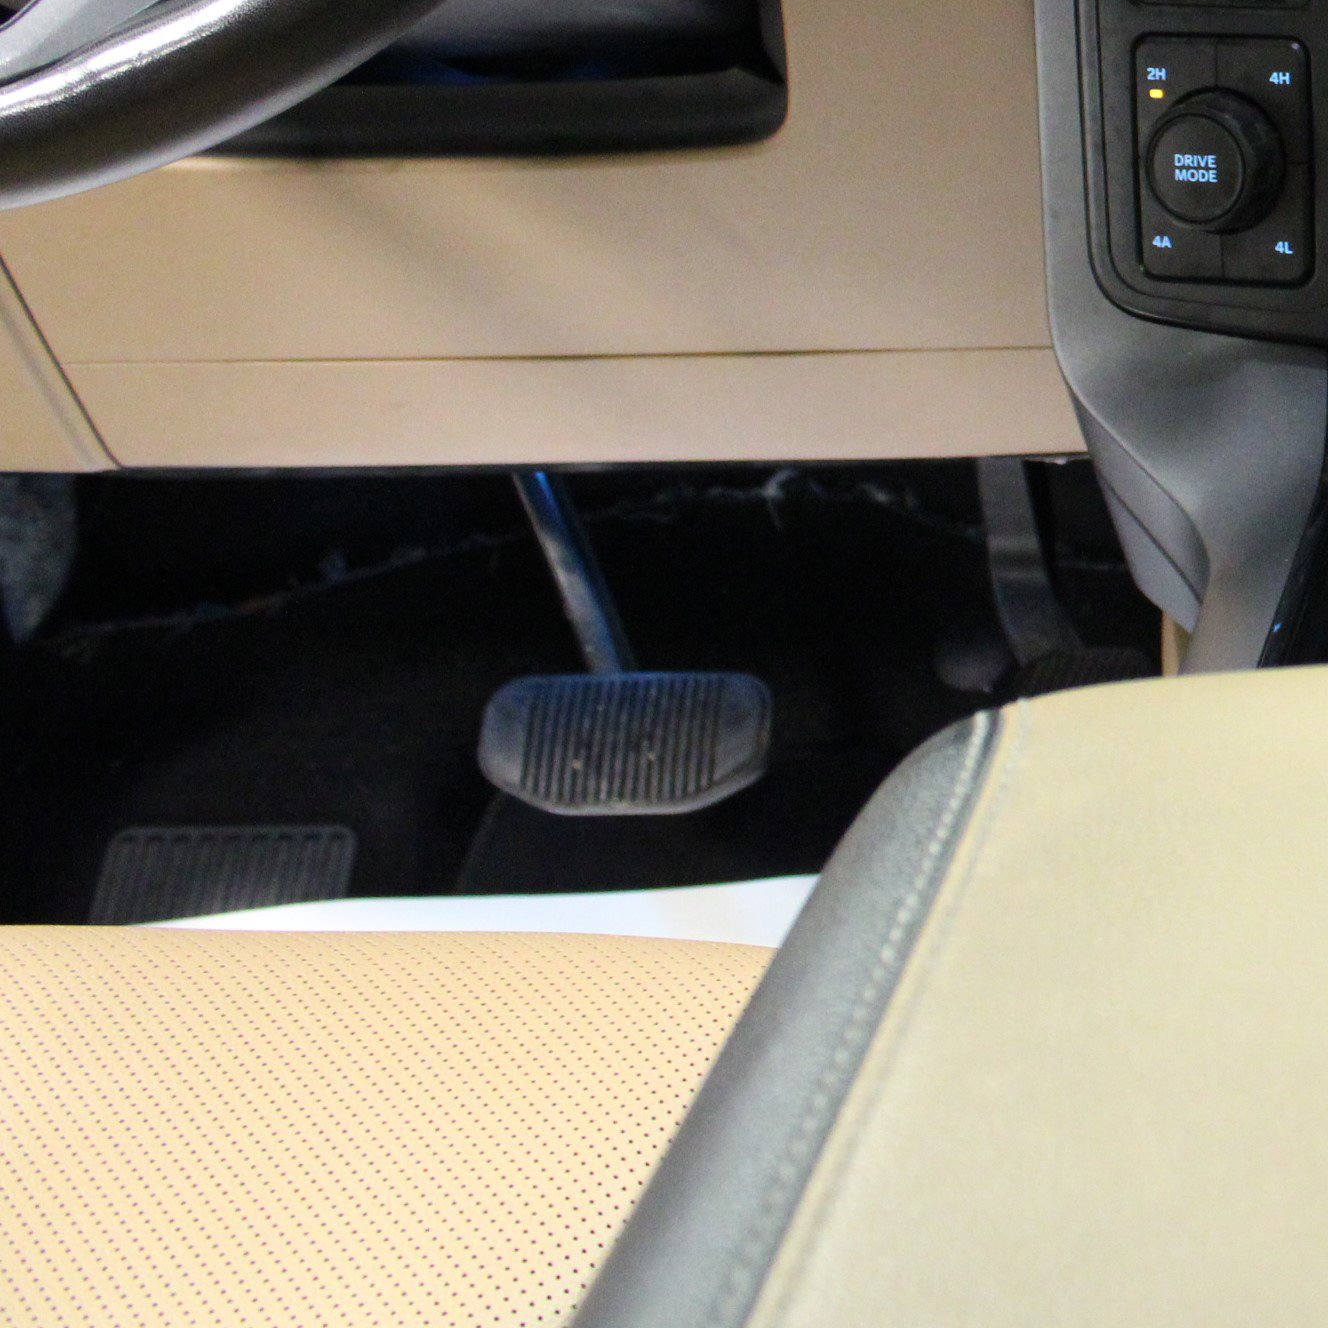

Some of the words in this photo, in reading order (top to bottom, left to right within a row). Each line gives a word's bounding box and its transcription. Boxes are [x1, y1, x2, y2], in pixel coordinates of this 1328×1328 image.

[1146, 67, 1167, 81] 2H
[1269, 72, 1290, 85] 4H
[1174, 154, 1217, 168] DRIVE
[1174, 169, 1218, 183] MODE
[1152, 235, 1172, 249] 4A
[1275, 241, 1293, 254] 4L
